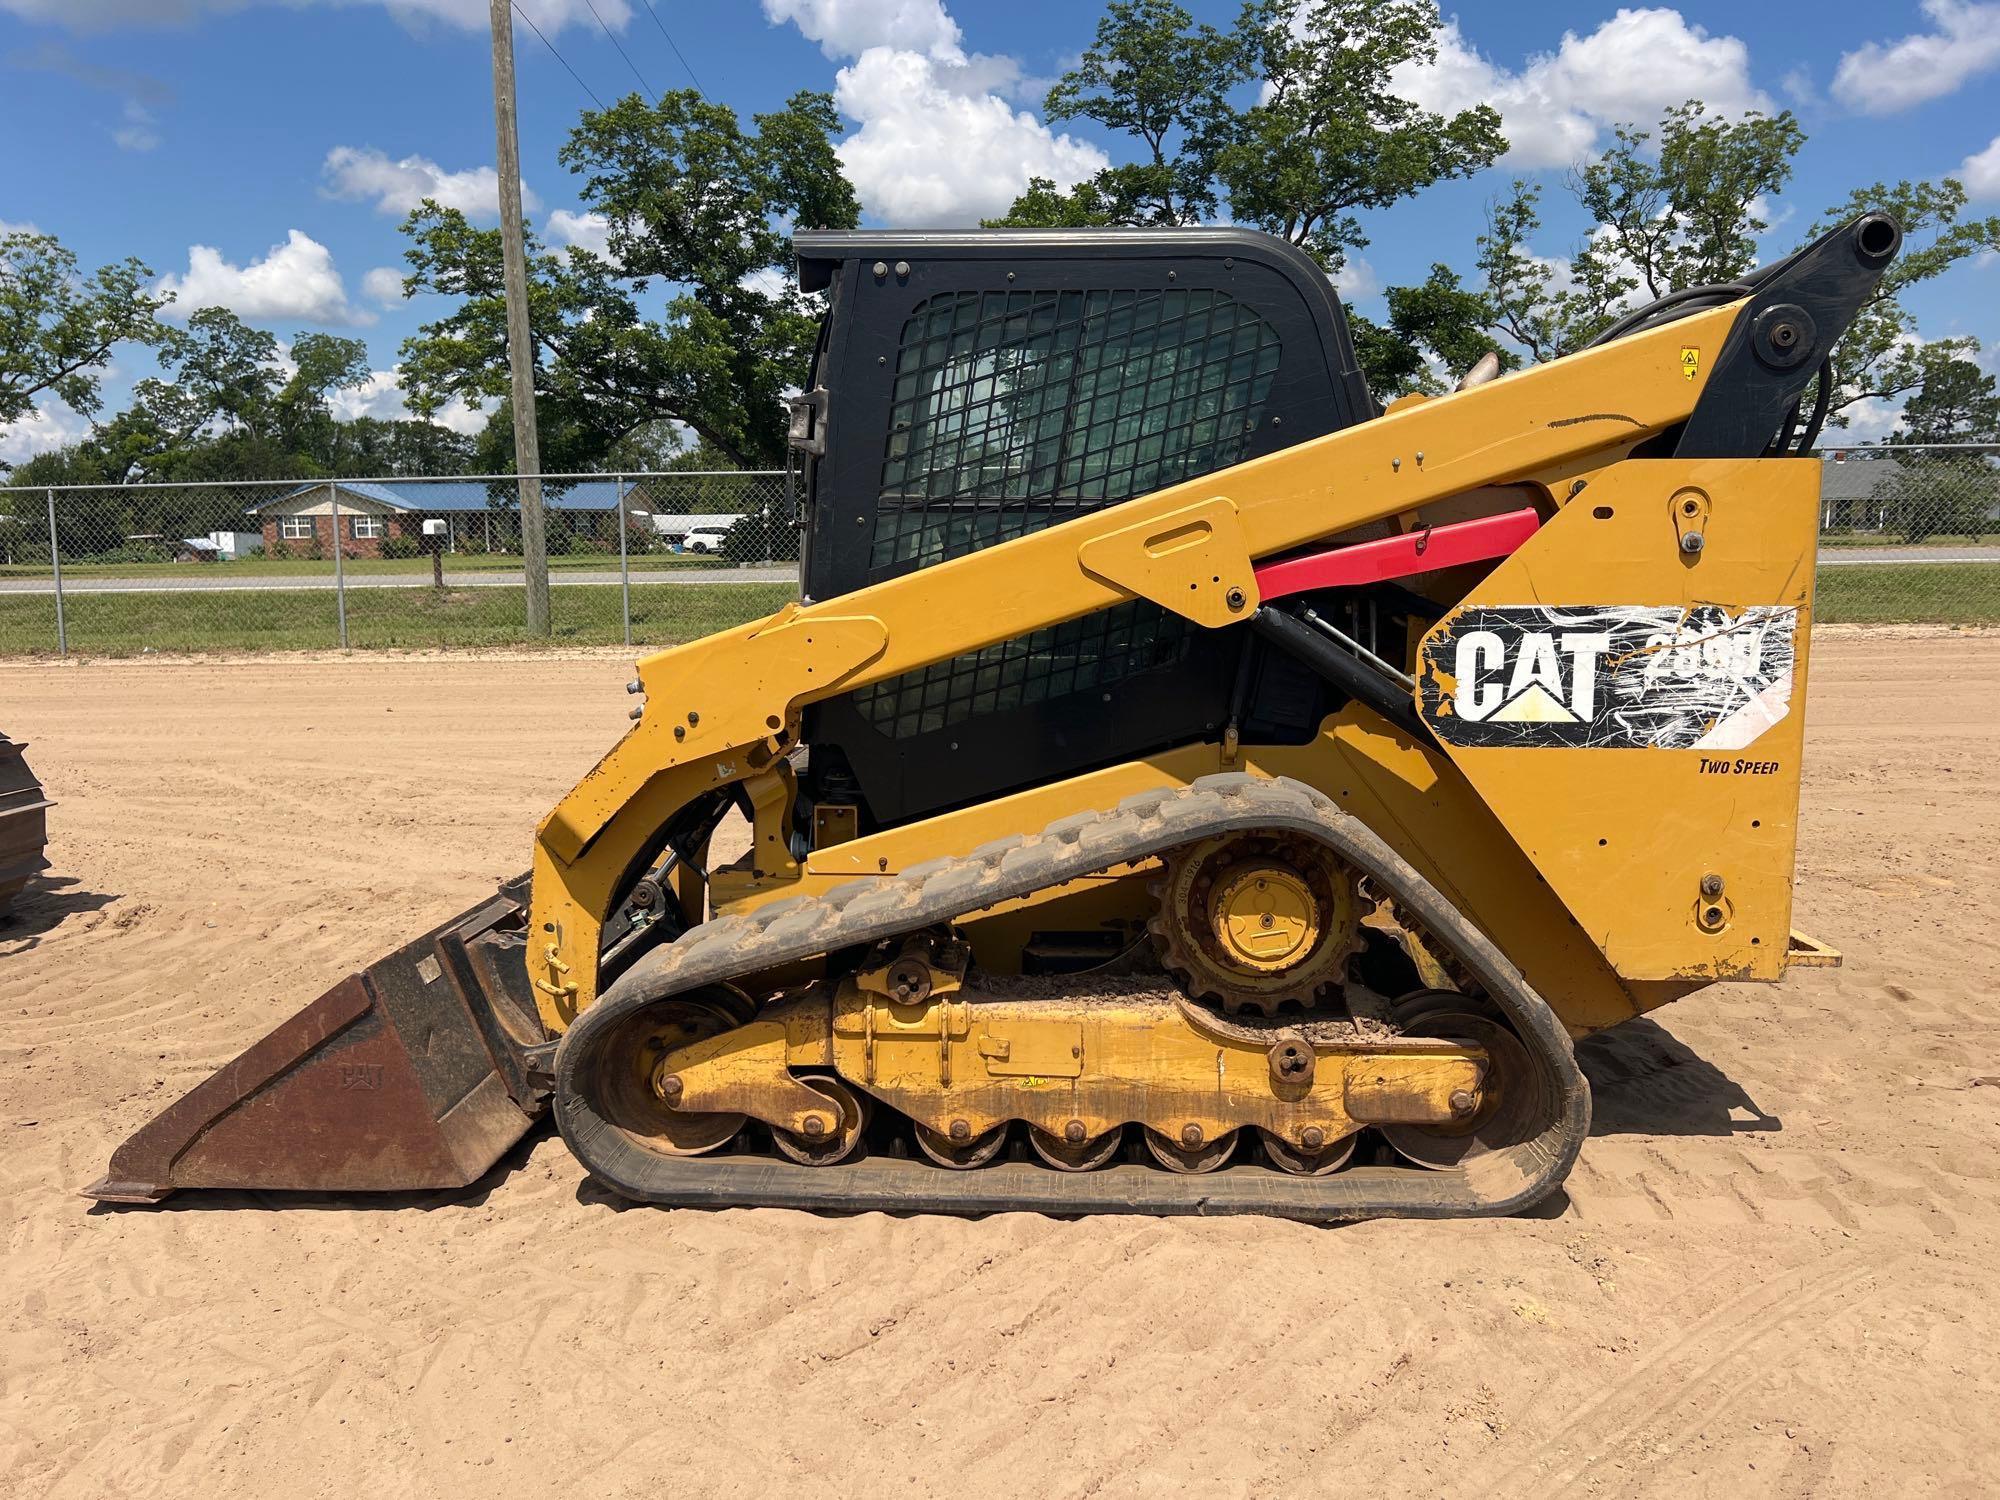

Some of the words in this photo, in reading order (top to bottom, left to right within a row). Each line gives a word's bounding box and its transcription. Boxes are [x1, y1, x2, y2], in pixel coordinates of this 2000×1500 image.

[1454, 631, 1610, 723] CAT
[1699, 758, 1730, 774] TWO
[340, 1063, 385, 1091] CAT
